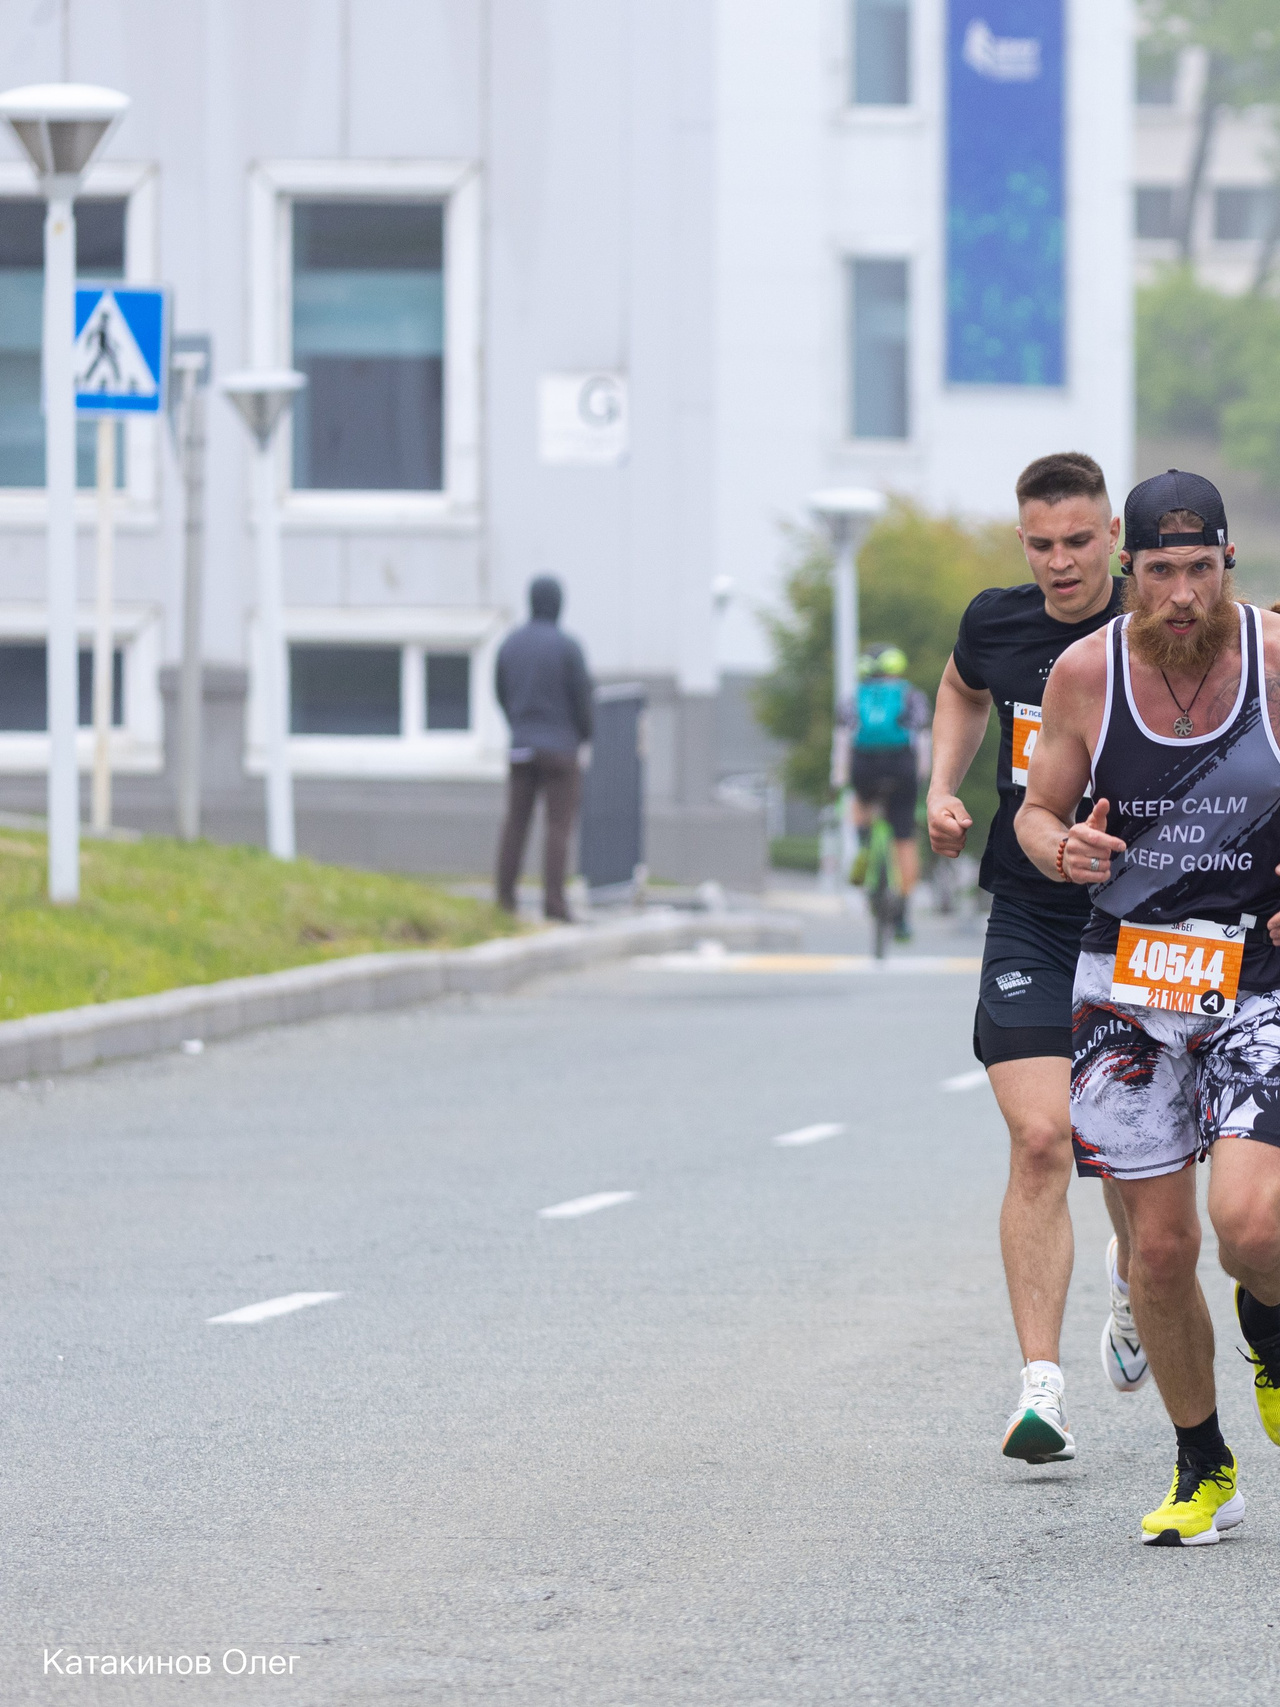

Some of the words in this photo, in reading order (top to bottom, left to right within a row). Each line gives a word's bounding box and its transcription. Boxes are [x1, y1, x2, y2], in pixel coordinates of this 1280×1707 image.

[1118, 799, 1175, 818] KEEP
[1181, 796, 1248, 815] CALM
[1157, 824, 1206, 844] AND
[1124, 847, 1174, 871] KEEP
[1180, 852, 1253, 873] GOING
[1128, 938, 1225, 989] 40544
[995, 970, 1022, 986] DEFEND
[999, 976, 1033, 992] YOURSELF
